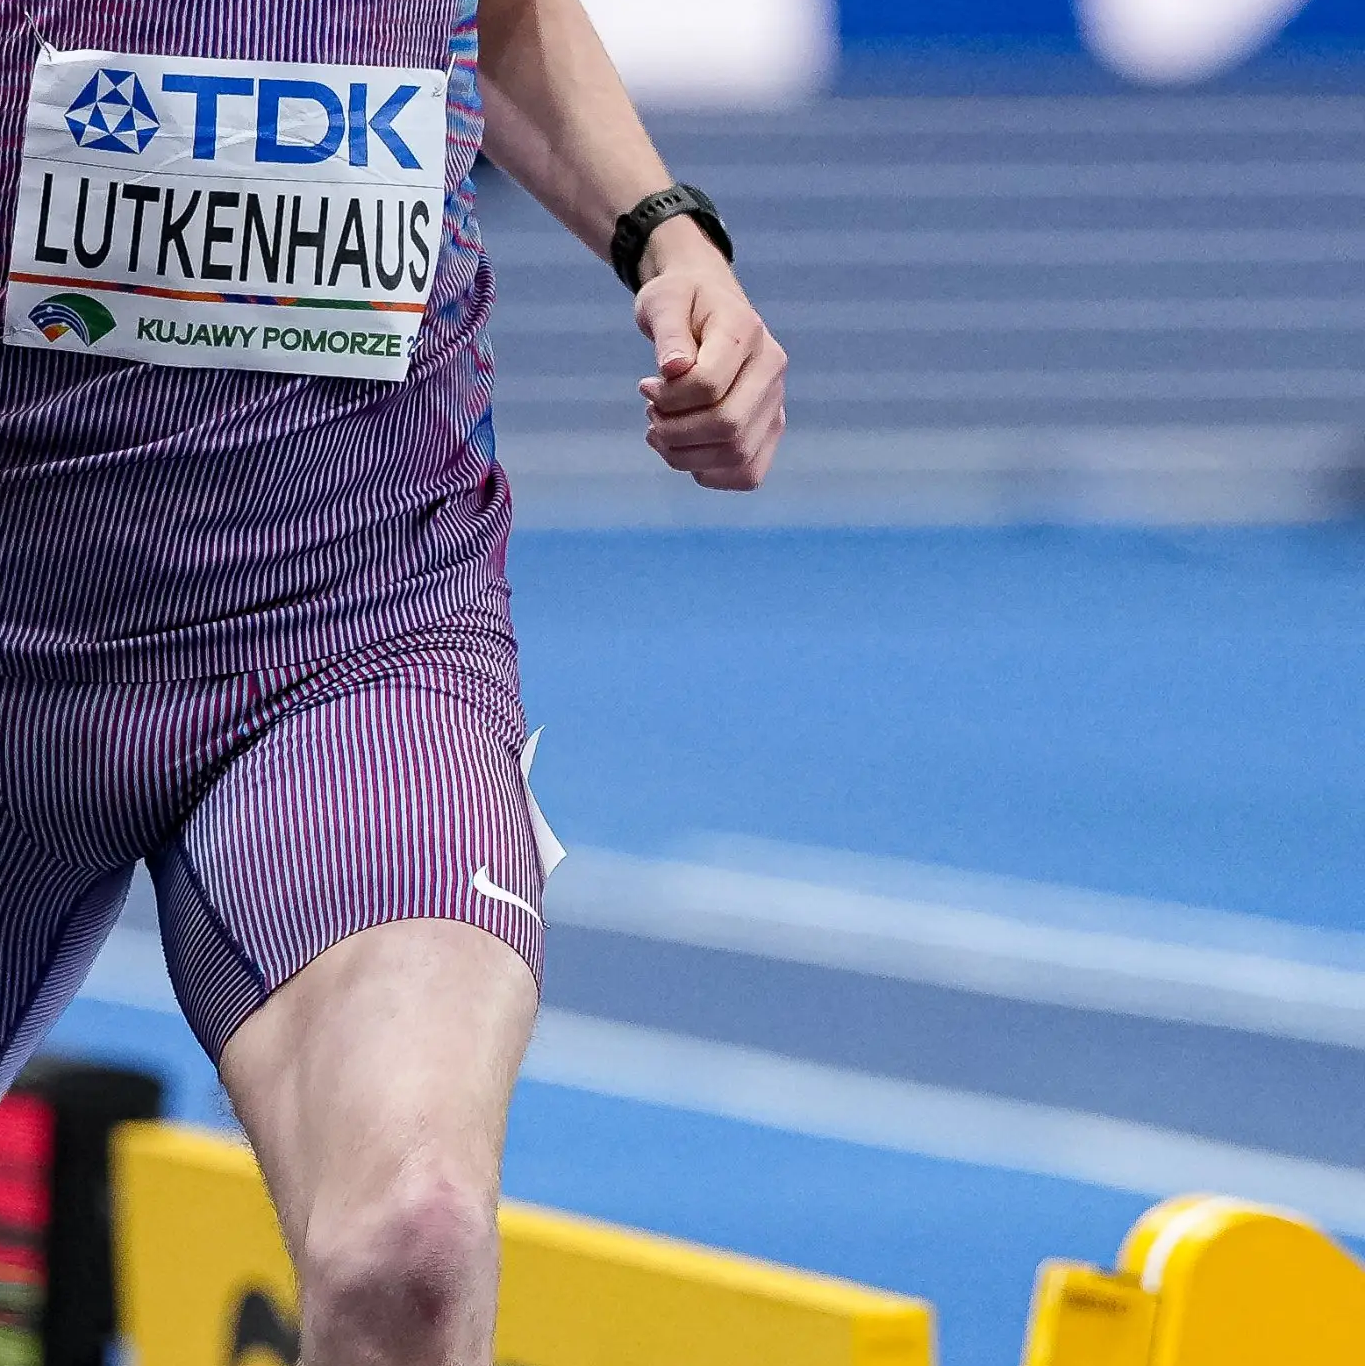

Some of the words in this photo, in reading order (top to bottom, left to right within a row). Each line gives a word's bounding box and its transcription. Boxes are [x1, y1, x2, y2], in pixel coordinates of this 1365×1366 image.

[160, 73, 424, 170] TDK
[34, 173, 431, 294] LUTKENHAUS
[136, 316, 257, 348] KUJAWY
[262, 327, 402, 358] POMORZE
